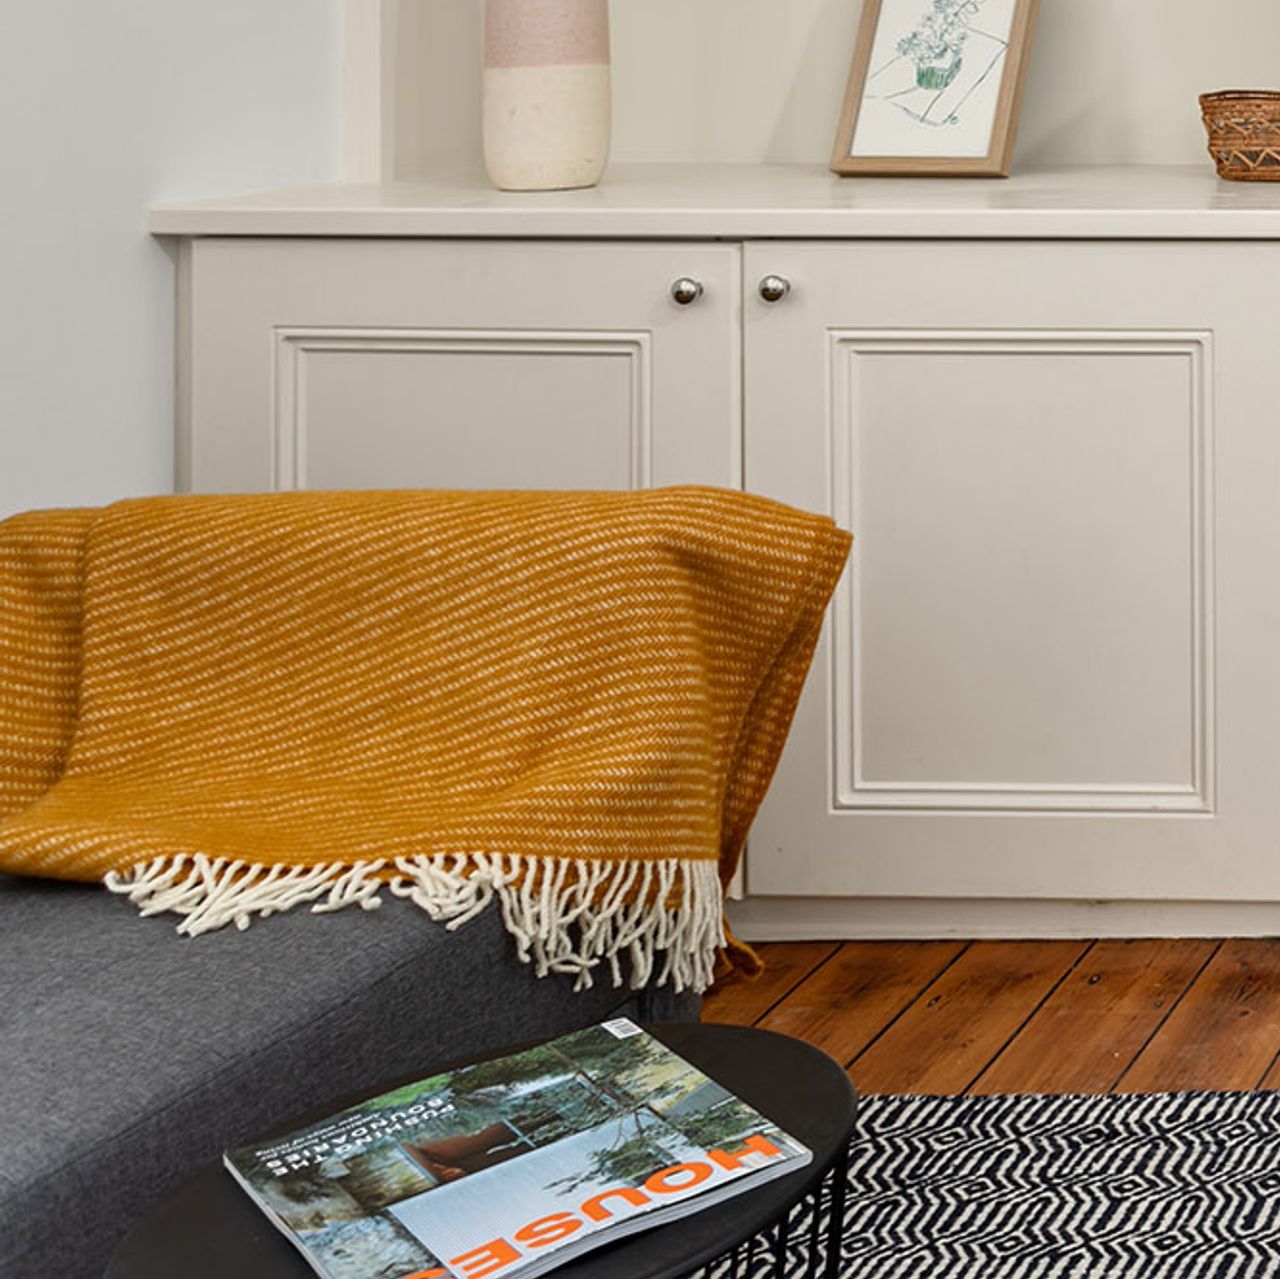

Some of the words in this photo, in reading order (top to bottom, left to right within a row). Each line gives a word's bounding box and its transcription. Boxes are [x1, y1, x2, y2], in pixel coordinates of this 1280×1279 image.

[266, 1098, 443, 1168] BOUNDARIES
[334, 1104, 455, 1155] PUSHING
[271, 1155, 328, 1177] THE
[400, 1134, 782, 1279] HOUSE
